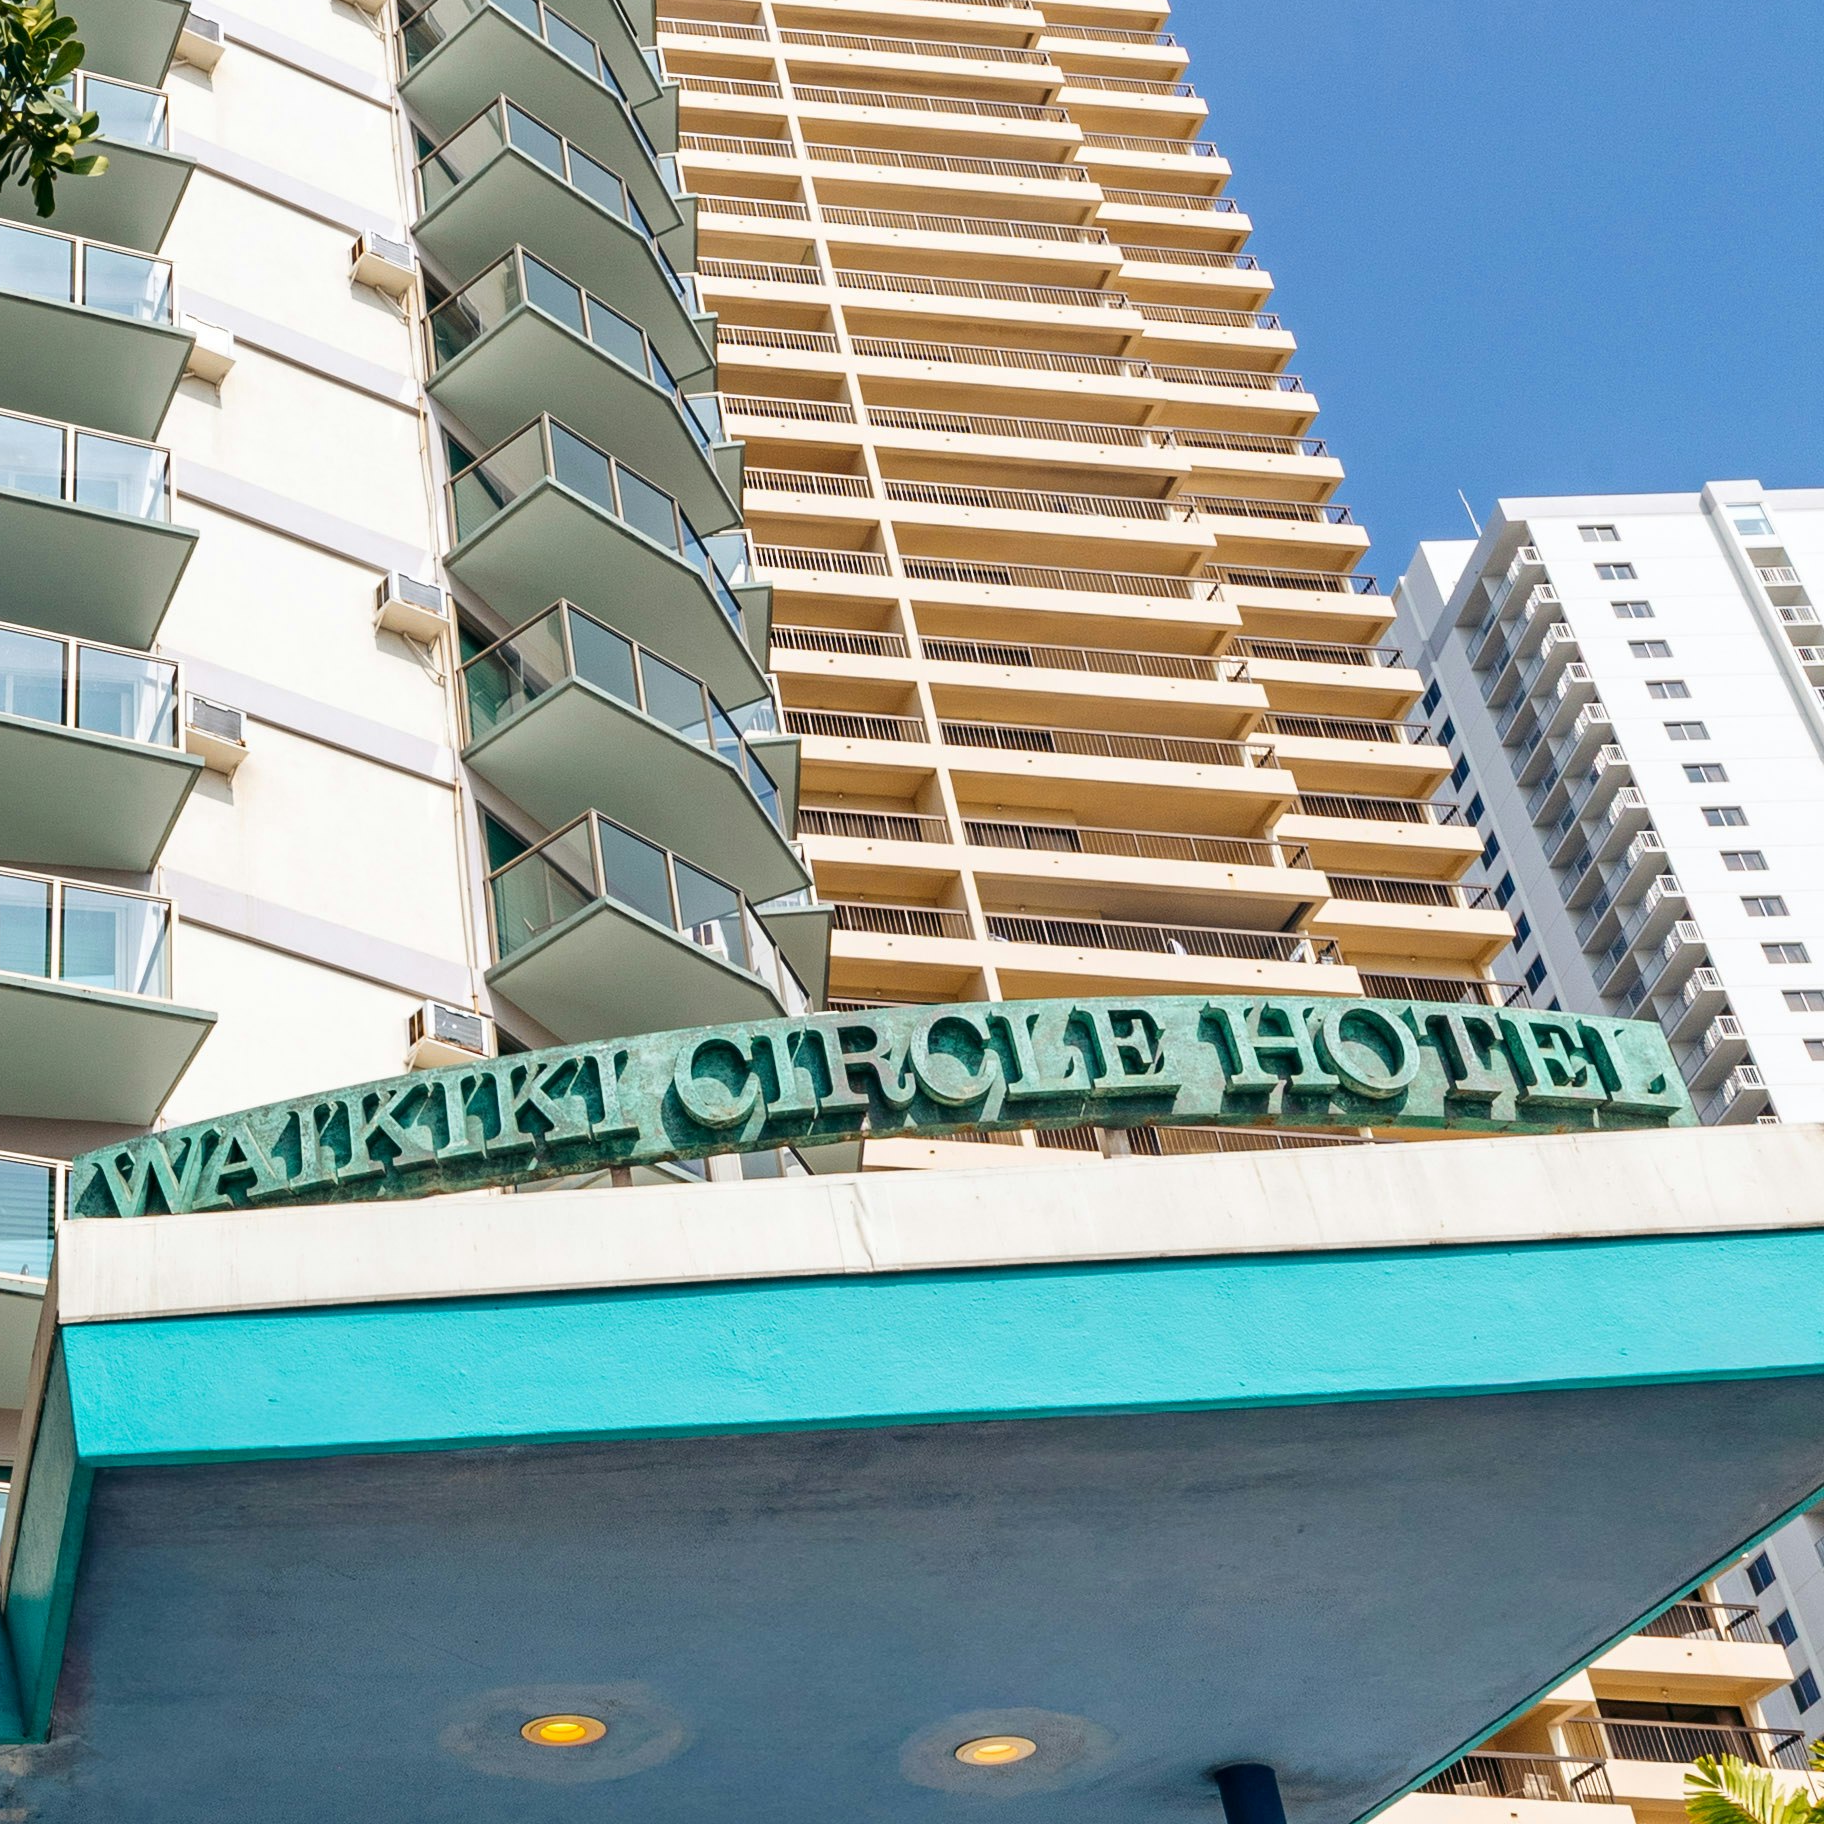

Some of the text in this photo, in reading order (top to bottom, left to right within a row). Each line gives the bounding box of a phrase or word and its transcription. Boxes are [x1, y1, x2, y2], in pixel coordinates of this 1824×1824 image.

[90, 1002, 1684, 1217] WAIKIKI CIRCLE HOTEL
